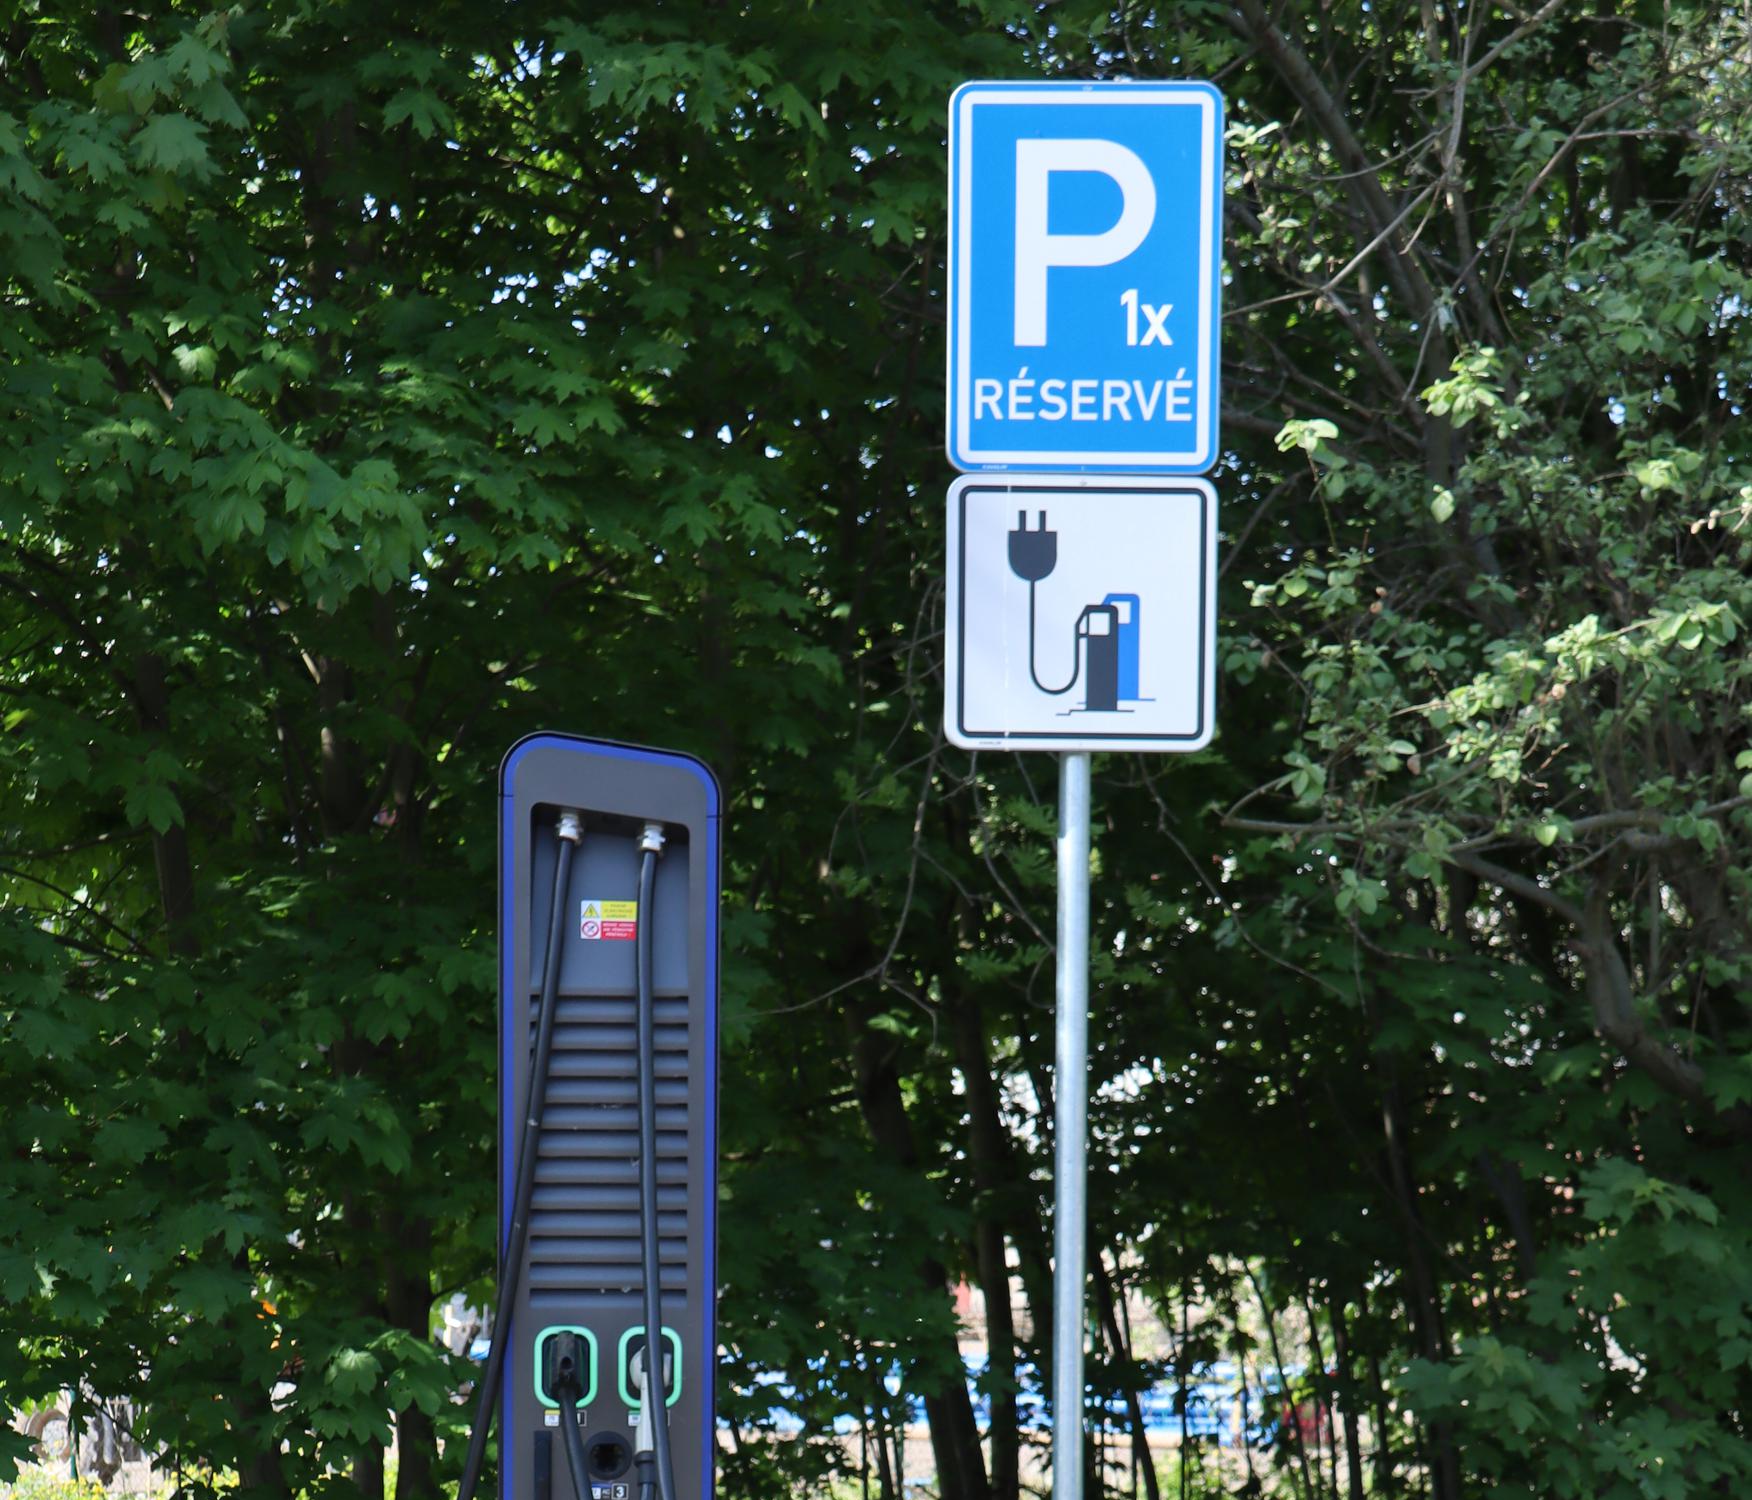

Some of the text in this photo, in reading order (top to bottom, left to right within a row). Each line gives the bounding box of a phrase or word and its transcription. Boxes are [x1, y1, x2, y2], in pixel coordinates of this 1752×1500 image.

[1014, 138, 1157, 346] P
[1120, 288, 1174, 346] 1x
[974, 366, 1193, 422] RÉSERVÉ
[616, 1486, 625, 1498] 3
